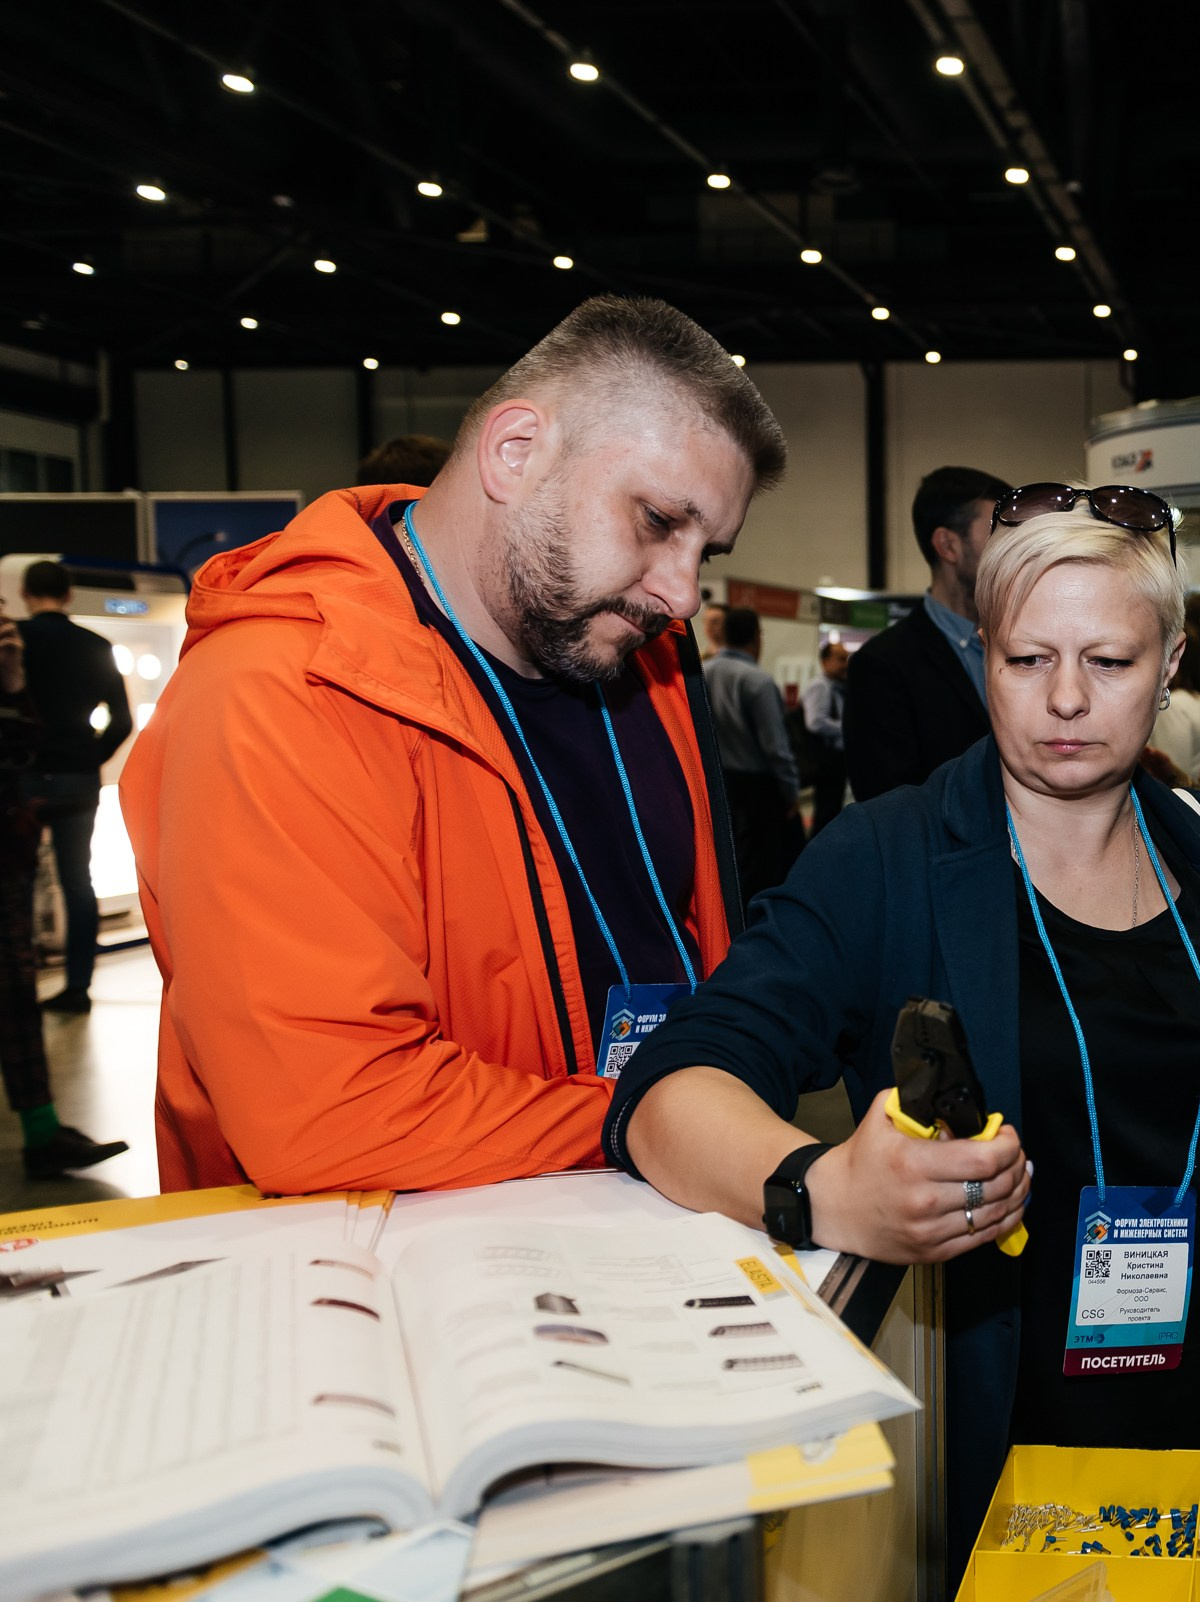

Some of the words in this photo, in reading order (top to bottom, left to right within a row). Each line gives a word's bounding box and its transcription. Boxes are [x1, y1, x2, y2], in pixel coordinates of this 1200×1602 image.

[659, 1013, 667, 1023] ЭЛ
[1114, 1218, 1138, 1228] ФОРУМ
[1139, 1218, 1189, 1228] ЭЛЕКТРОТЕХНИКИ
[1113, 1229, 1119, 1239] И
[1120, 1229, 1162, 1239] ИНЖЕНЕРНЫХ
[1163, 1228, 1188, 1238] СИСТЕМ
[1124, 1250, 1169, 1260] ВИНИЦКАЯ
[1127, 1262, 1164, 1271] Кристина
[1121, 1272, 1168, 1281] Николаевна
[1081, 1308, 1105, 1320] CSG
[1119, 1307, 1161, 1315] Руководитель
[1127, 1315, 1151, 1323] проекта
[1073, 1335, 1093, 1344] ЭТМ
[1081, 1354, 1166, 1370] ПОСЕТИТЕЛЬ
